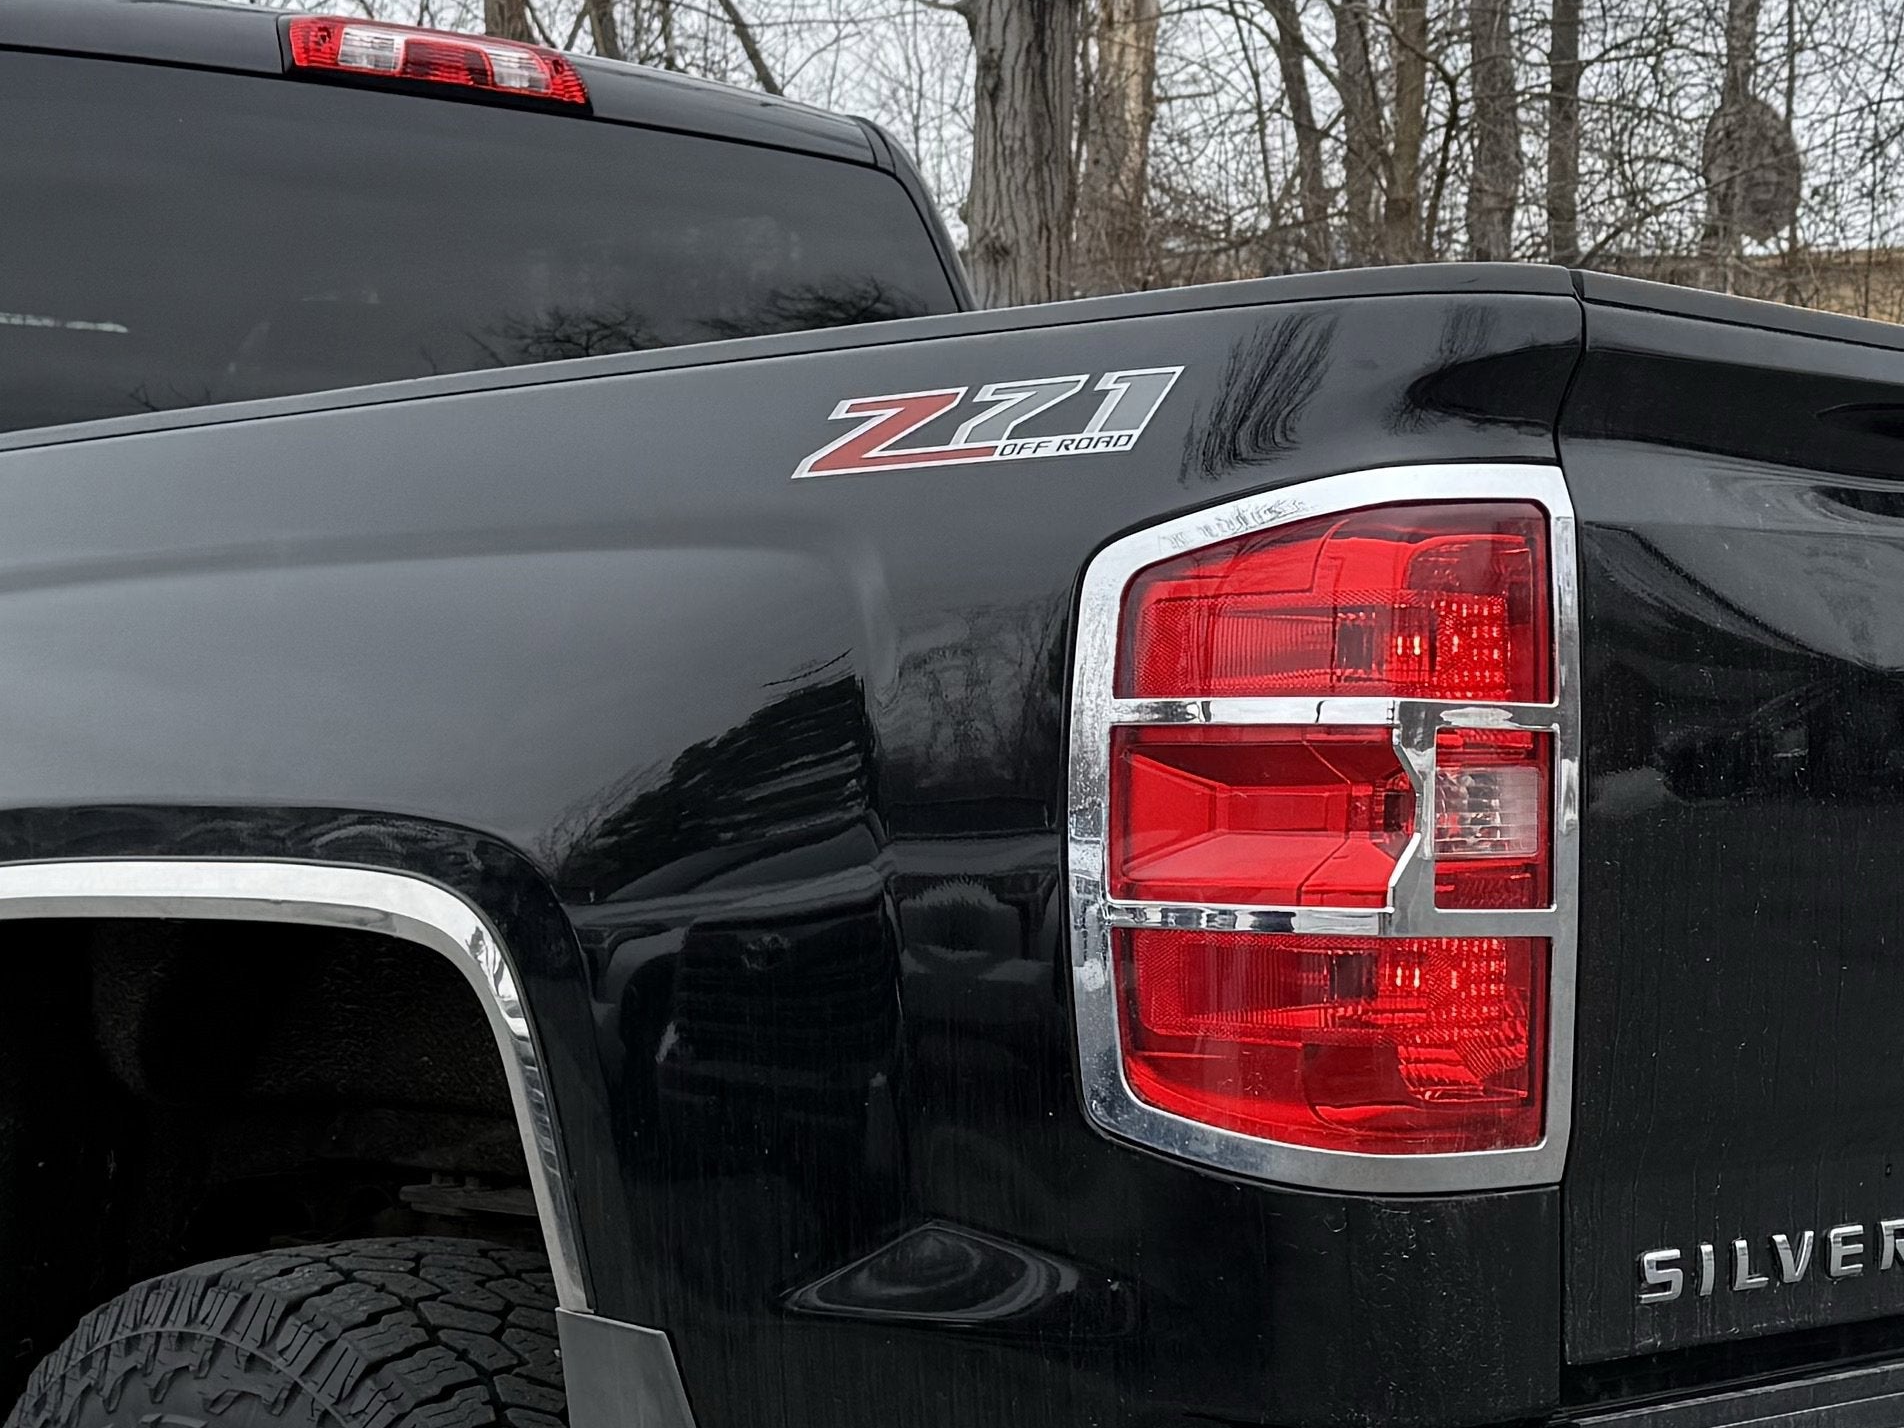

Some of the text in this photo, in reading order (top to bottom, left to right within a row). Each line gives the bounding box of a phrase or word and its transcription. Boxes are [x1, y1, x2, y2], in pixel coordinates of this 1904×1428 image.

[791, 366, 1185, 479] Z71
[998, 433, 1134, 457] OFF ROAD
